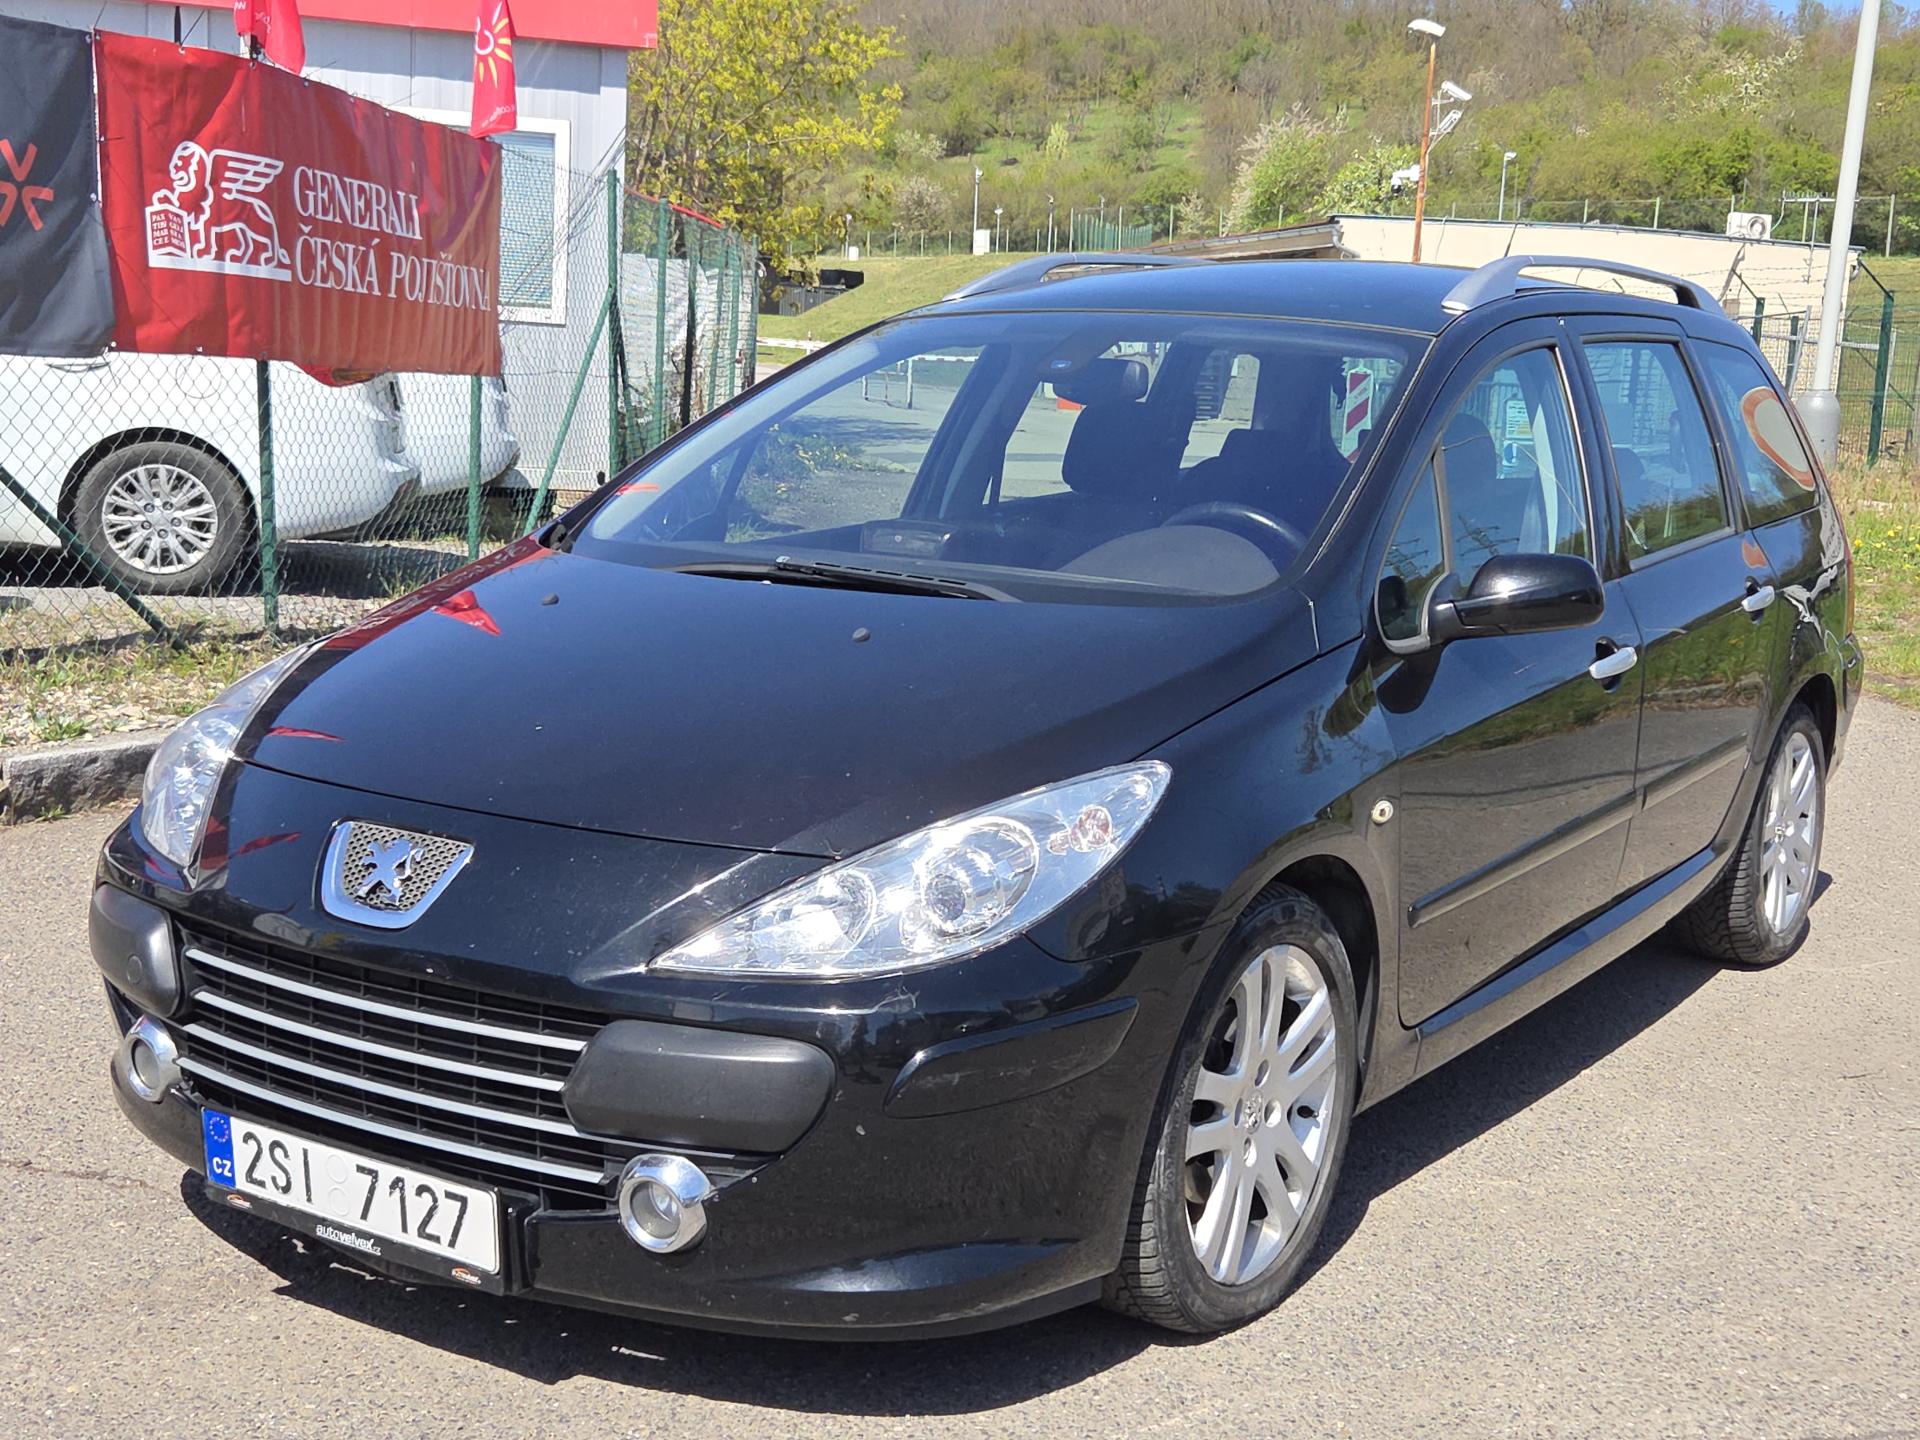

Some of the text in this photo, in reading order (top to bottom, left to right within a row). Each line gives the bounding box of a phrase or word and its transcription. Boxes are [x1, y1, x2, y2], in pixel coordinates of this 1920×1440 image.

[294, 165, 423, 240] GENERALI
[295, 223, 381, 296] ČESKÁ
[212, 1157, 233, 1178] CZ
[242, 1131, 468, 1249] 2SI 7127
